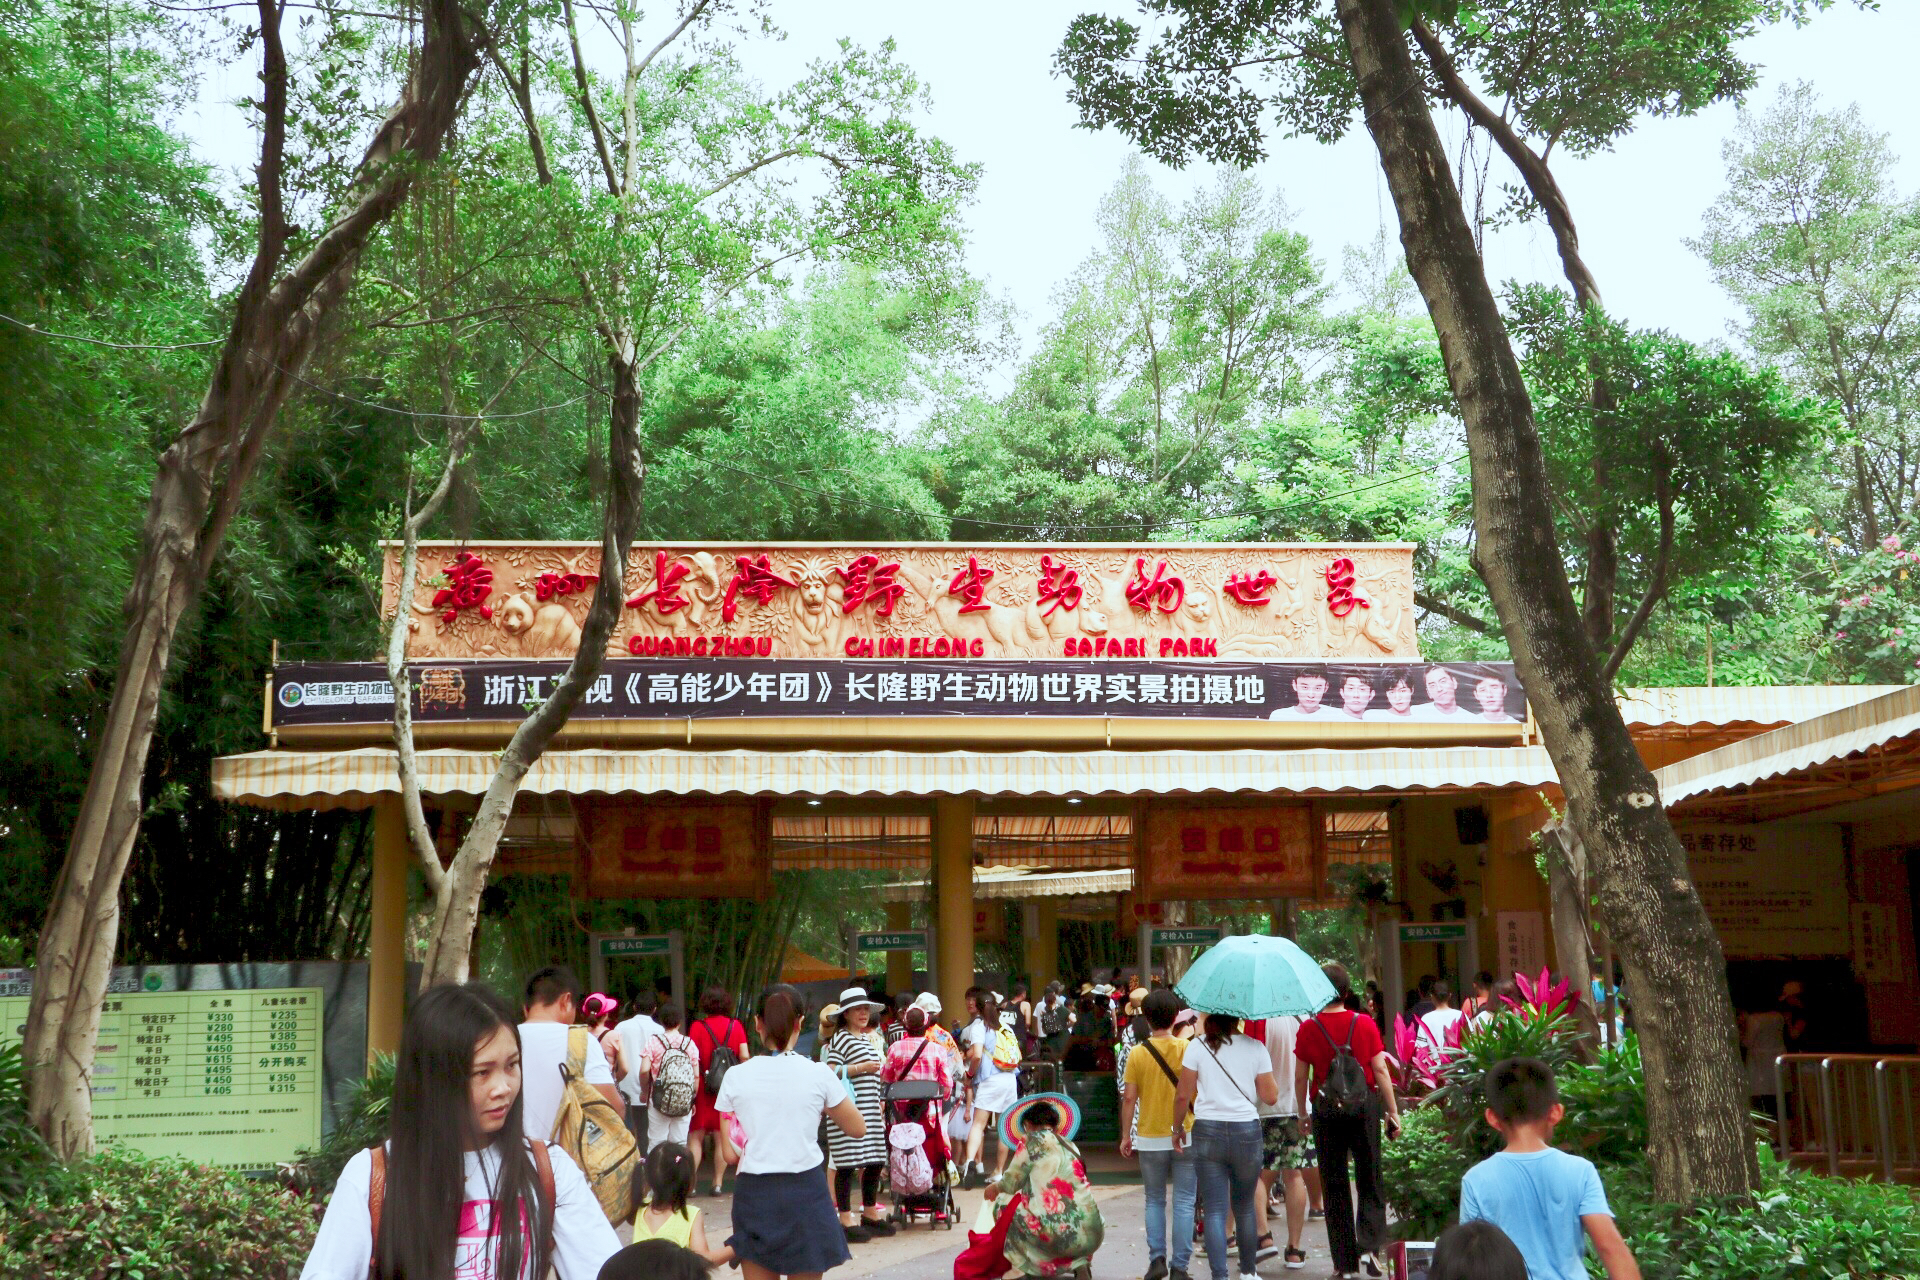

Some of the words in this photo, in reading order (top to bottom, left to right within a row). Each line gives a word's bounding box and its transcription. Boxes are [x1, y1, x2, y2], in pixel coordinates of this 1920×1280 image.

[628, 635, 773, 657] GUANGZHOU
[845, 636, 984, 657] CHIMELONG
[1064, 636, 1146, 657] SAFARI
[1160, 637, 1217, 657] PARK
[484, 671, 1266, 705] 浙江视《高能少年团》长隆野生动物世界实景拍摄地
[866, 937, 900, 945] 安检入口
[1160, 932, 1193, 940] 安检入口
[142, 1015, 176, 1024] 特定日子
[207, 1012, 234, 1022] ¥330
[271, 1011, 297, 1020] ¥235
[146, 1025, 163, 1033] 平日
[207, 1023, 233, 1032] ¥280
[270, 1021, 297, 1030] ¥200
[136, 1035, 171, 1044] 特定日子
[206, 1033, 233, 1043] ¥495
[270, 1031, 297, 1040] ¥385
[145, 1046, 162, 1054] 平日
[206, 1044, 233, 1053] ¥450
[270, 1042, 297, 1051] ¥350
[136, 1056, 170, 1065] 特定日子
[206, 1055, 233, 1064] ¥615
[259, 1056, 307, 1067] 分开购买
[144, 1067, 162, 1075] 平日
[205, 1066, 232, 1075] ¥495
[134, 1078, 169, 1087] 特定日子
[205, 1076, 232, 1085] ¥450
[269, 1074, 296, 1083] ¥350
[143, 1089, 161, 1097] 平日
[204, 1086, 232, 1095] ¥405
[269, 1084, 296, 1093] ¥315
